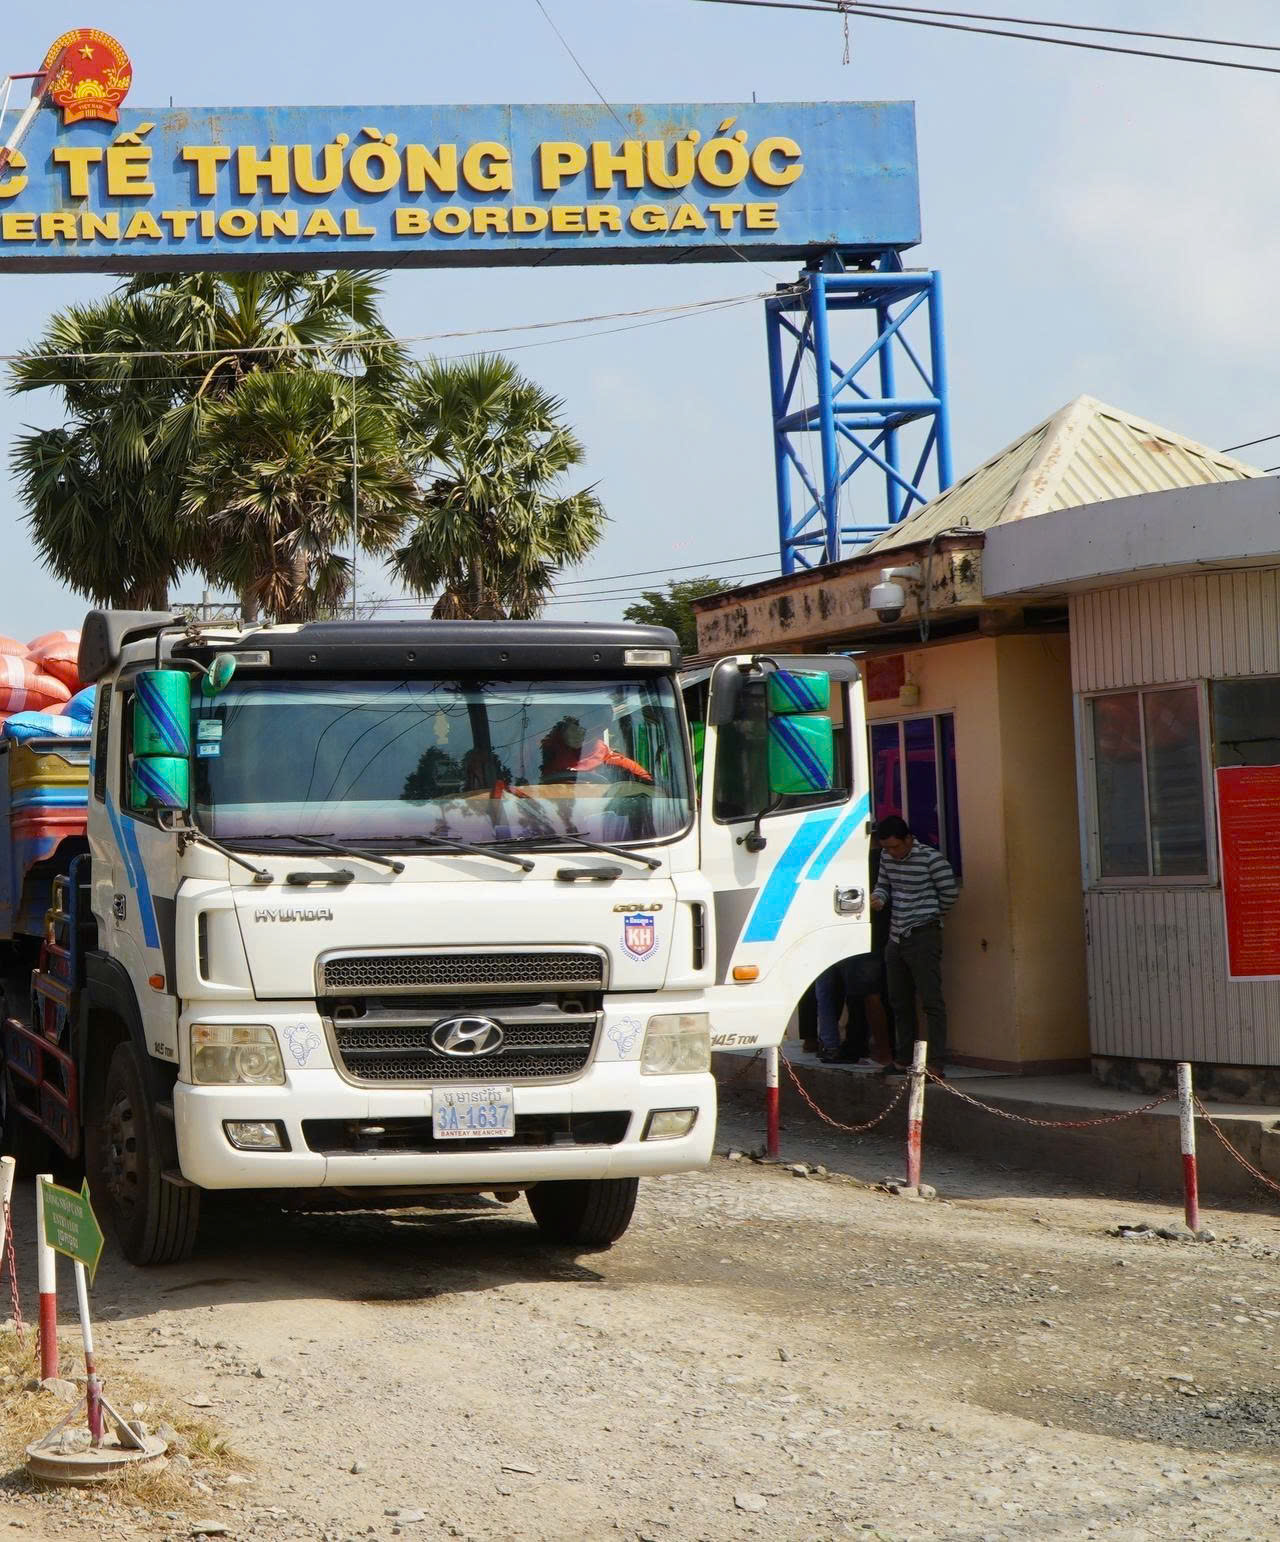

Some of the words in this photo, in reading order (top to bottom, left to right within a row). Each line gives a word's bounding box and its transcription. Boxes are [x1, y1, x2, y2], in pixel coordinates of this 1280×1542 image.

[53, 122, 155, 197] TẾ
[183, 126, 512, 195] THƯỜNG
[540, 117, 804, 190] PHƯỚC
[255, 908, 334, 923] HYUNDAI
[612, 903, 664, 913] GOLD
[628, 928, 651, 945] KH
[737, 1035, 760, 1045] TON
[439, 1104, 509, 1129] 3A-1637
[440, 1129, 471, 1137] BANTEAY
[472, 1129, 507, 1137] MEANCHEY
